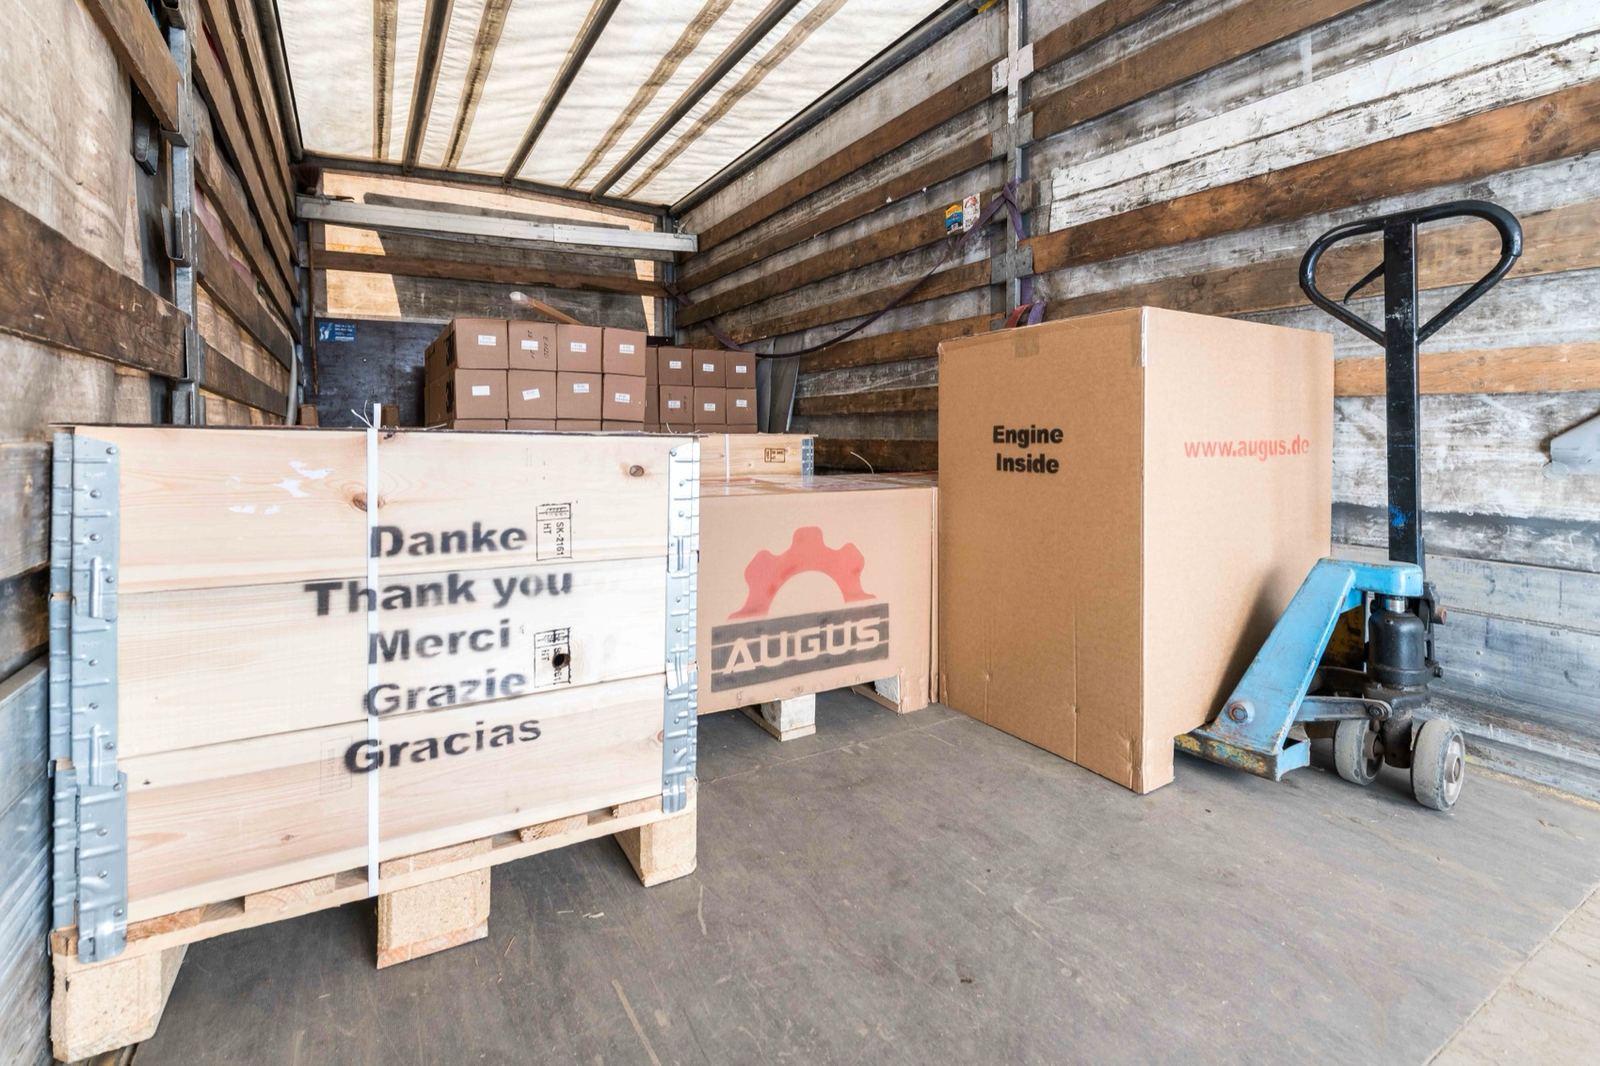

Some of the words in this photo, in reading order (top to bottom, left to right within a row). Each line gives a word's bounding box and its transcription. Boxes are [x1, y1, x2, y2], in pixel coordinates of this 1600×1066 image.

[993, 425, 1064, 448] Engine
[1184, 434, 1311, 461] www.augus.de
[996, 453, 1060, 473] Inside
[371, 522, 527, 557] Danke
[543, 523, 552, 534] HT
[556, 521, 565, 556] SK-2161
[304, 574, 476, 616] Thank
[493, 572, 573, 609] you
[369, 618, 511, 664] Merci
[723, 618, 881, 674] AUGUS
[362, 669, 527, 716] Grazie
[344, 719, 541, 774] Gracias
